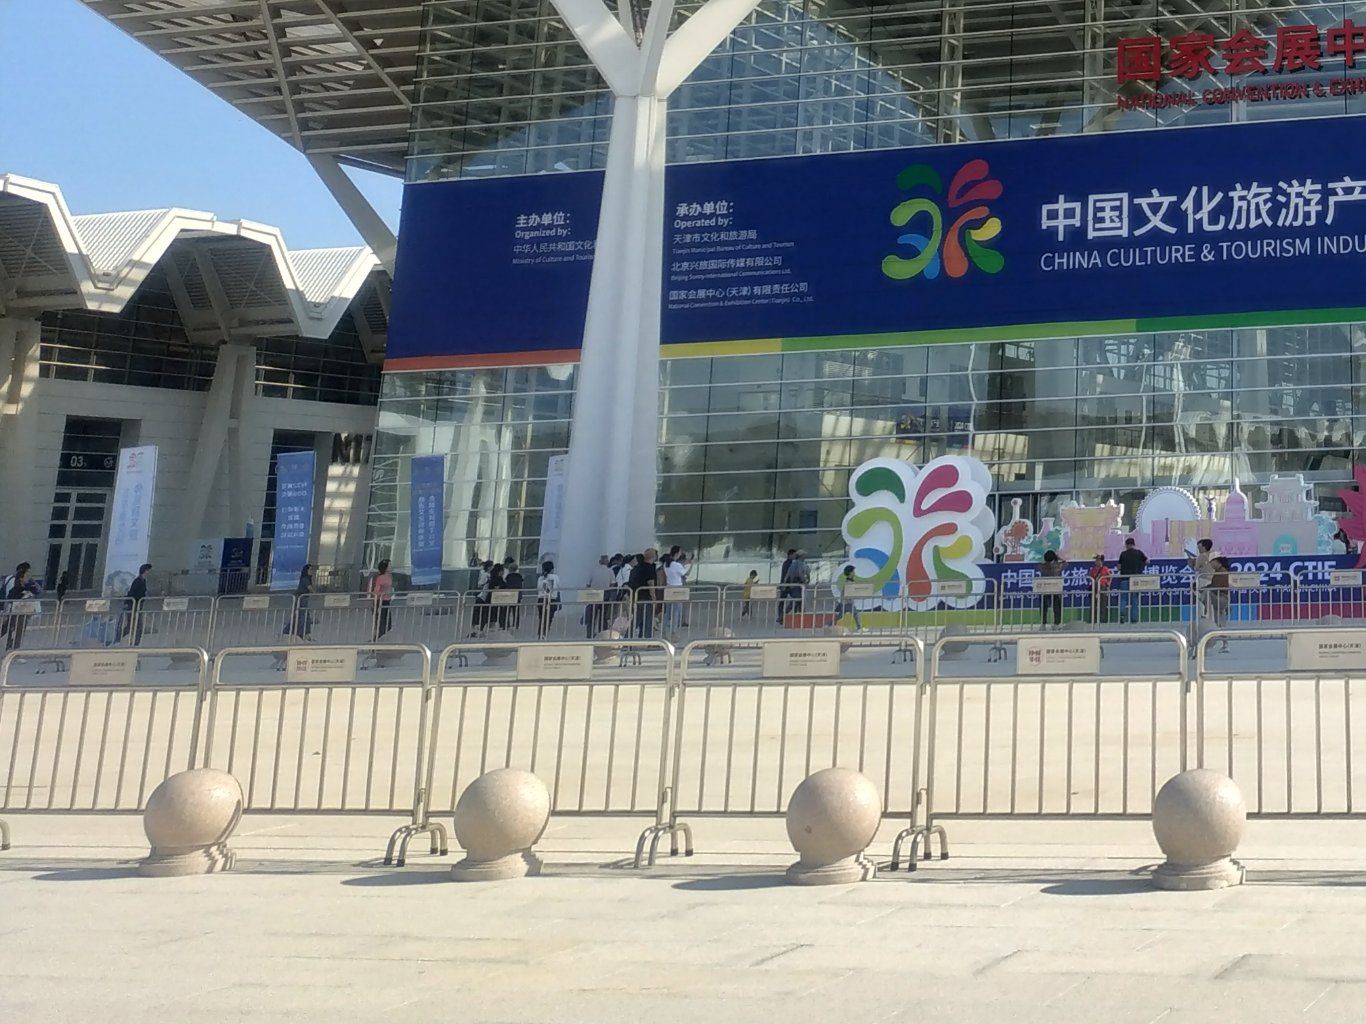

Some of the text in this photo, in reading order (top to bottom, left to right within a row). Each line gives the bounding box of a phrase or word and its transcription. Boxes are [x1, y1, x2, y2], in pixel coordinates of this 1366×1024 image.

[1117, 91, 1197, 110] NATIONAL
[1202, 83, 1307, 105] CONVENTION
[1313, 80, 1327, 97] &
[674, 217, 732, 229] Operated by:
[515, 228, 571, 239] Organized by:
[673, 230, 757, 244] 天津市文化和旅游局
[1040, 246, 1102, 271] CHINA
[1106, 241, 1197, 268] CULTURE
[1200, 241, 1215, 263] &
[1219, 236, 1311, 260] TOURISM
[1289, 560, 1336, 581] CTIE
